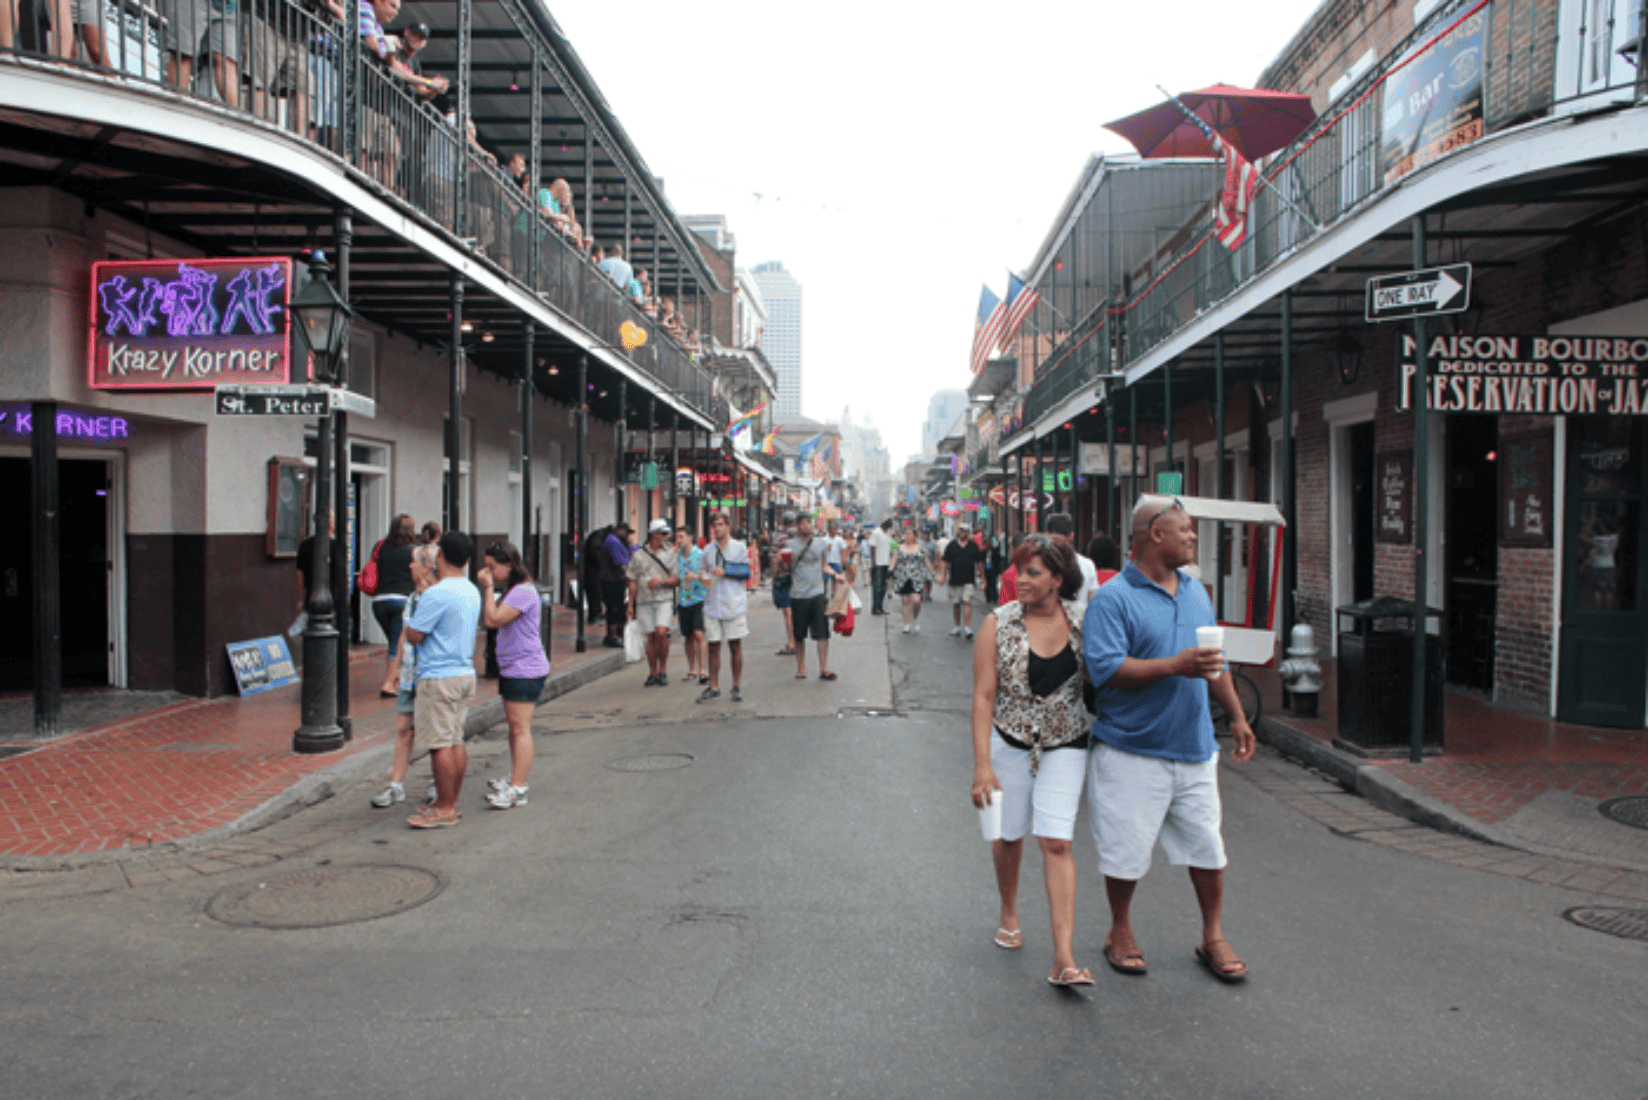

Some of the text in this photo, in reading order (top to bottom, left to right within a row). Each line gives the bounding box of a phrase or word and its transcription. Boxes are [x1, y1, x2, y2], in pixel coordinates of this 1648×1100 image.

[1377, 282, 1438, 306] ONE WAY
[108, 341, 278, 379] Krazy Korner
[1438, 360, 1638, 376] DEDICATED TO THE
[221, 395, 323, 414] St. Peter
[15, 411, 128, 438] KRNER
